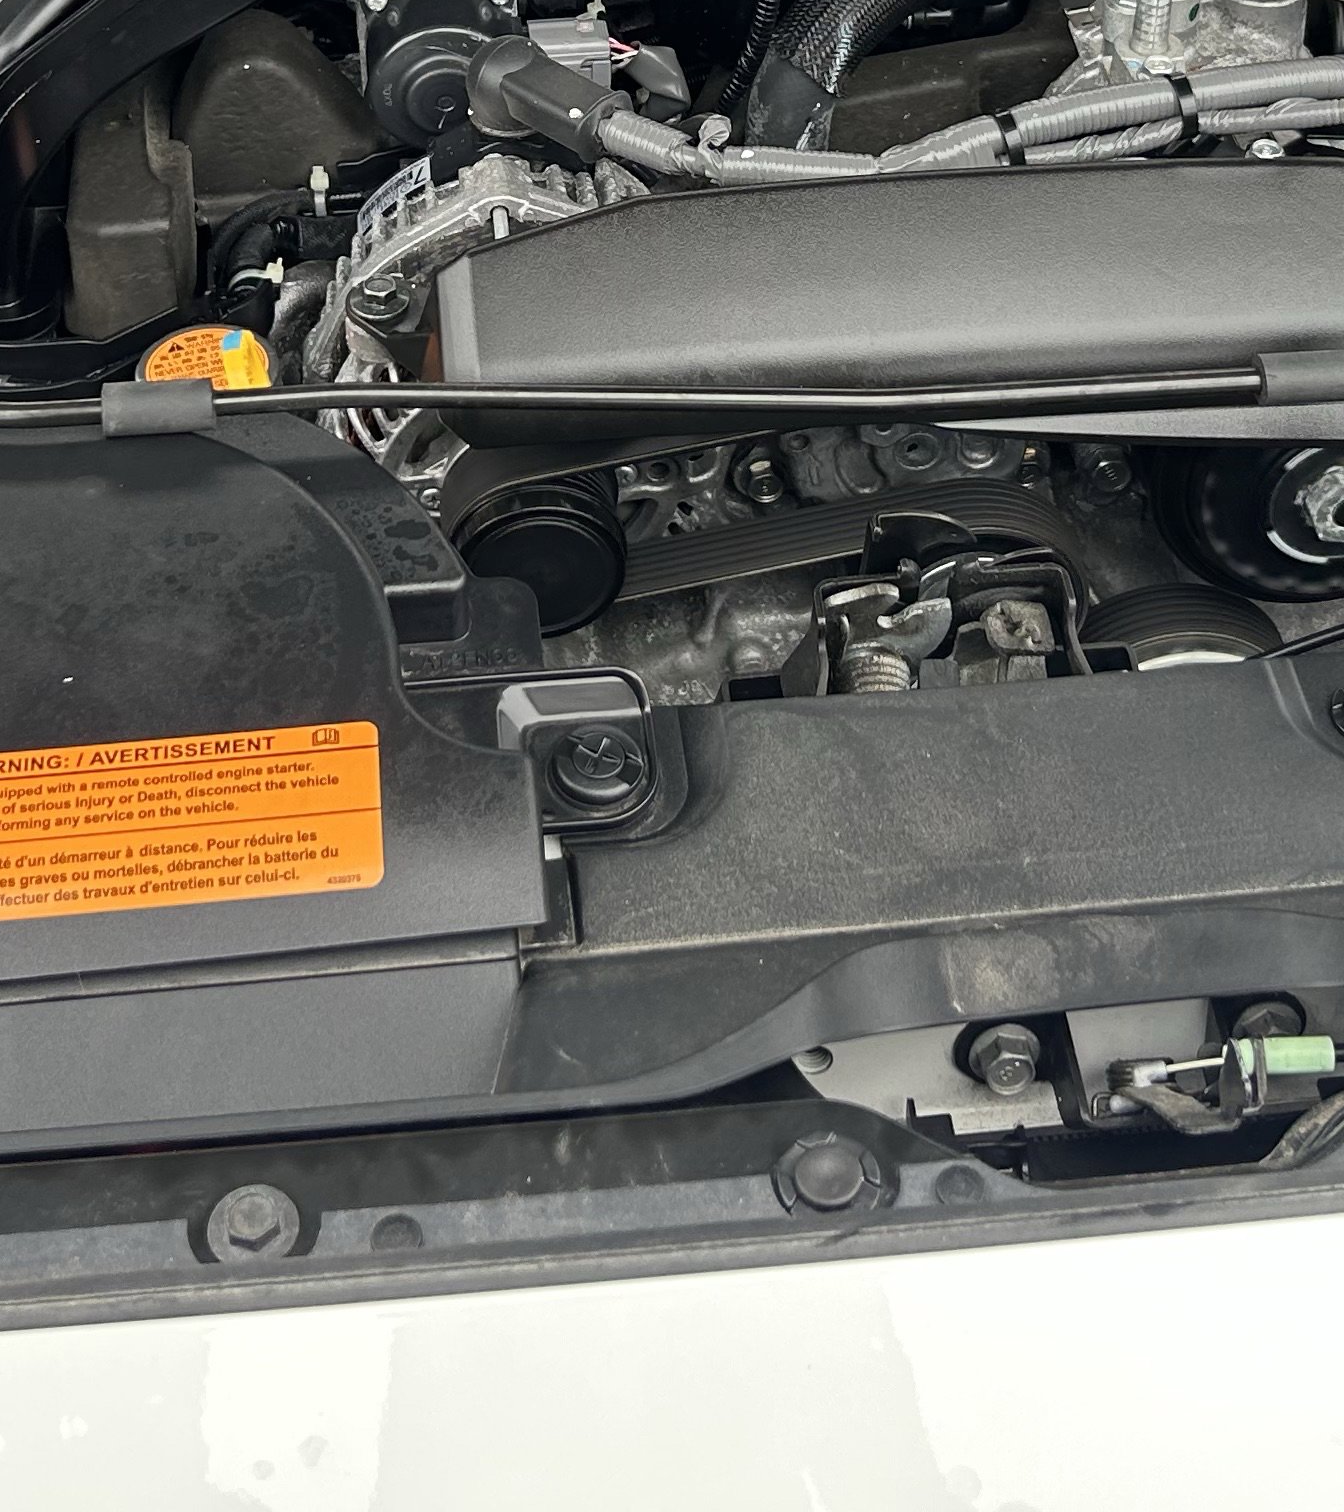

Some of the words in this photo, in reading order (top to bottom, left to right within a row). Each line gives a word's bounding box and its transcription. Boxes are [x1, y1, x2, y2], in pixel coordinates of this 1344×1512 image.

[89, 736, 276, 766] AVERTISSEMENT
[2, 803, 16, 815] of
[20, 799, 71, 812] serious
[75, 795, 115, 811] injury
[119, 795, 134, 805] or
[137, 788, 182, 804] Death,
[185, 781, 262, 798] disconnect
[265, 778, 287, 791] the
[290, 773, 340, 788] vehicle
[47, 783, 75, 795] with
[91, 777, 139, 790] remote
[143, 769, 213, 786] controlled
[216, 766, 263, 781] engine
[267, 761, 314, 774] starter.
[54, 816, 80, 829] any
[83, 809, 134, 823] service
[138, 809, 156, 820] on
[160, 804, 181, 817] the
[185, 800, 239, 815] vehicle.
[15, 854, 46, 868] d'un
[50, 848, 122, 866] démarreur
[139, 841, 203, 857] distance.
[207, 838, 241, 851] Pour
[244, 833, 293, 847] réduire
[297, 830, 317, 843] les
[20, 873, 68, 889] graves
[71, 872, 89, 883] ou
[93, 864, 163, 881] mortelles,
[167, 857, 244, 874] débrancher
[248, 852, 261, 866] la
[264, 849, 316, 864] batterie
[321, 846, 339, 858] du
[54, 889, 79, 902] des
[82, 885, 136, 900] travaux
[140, 877, 214, 894] d'entretien
[218, 875, 241, 887] sur
[245, 868, 300, 885] celui-ci.
